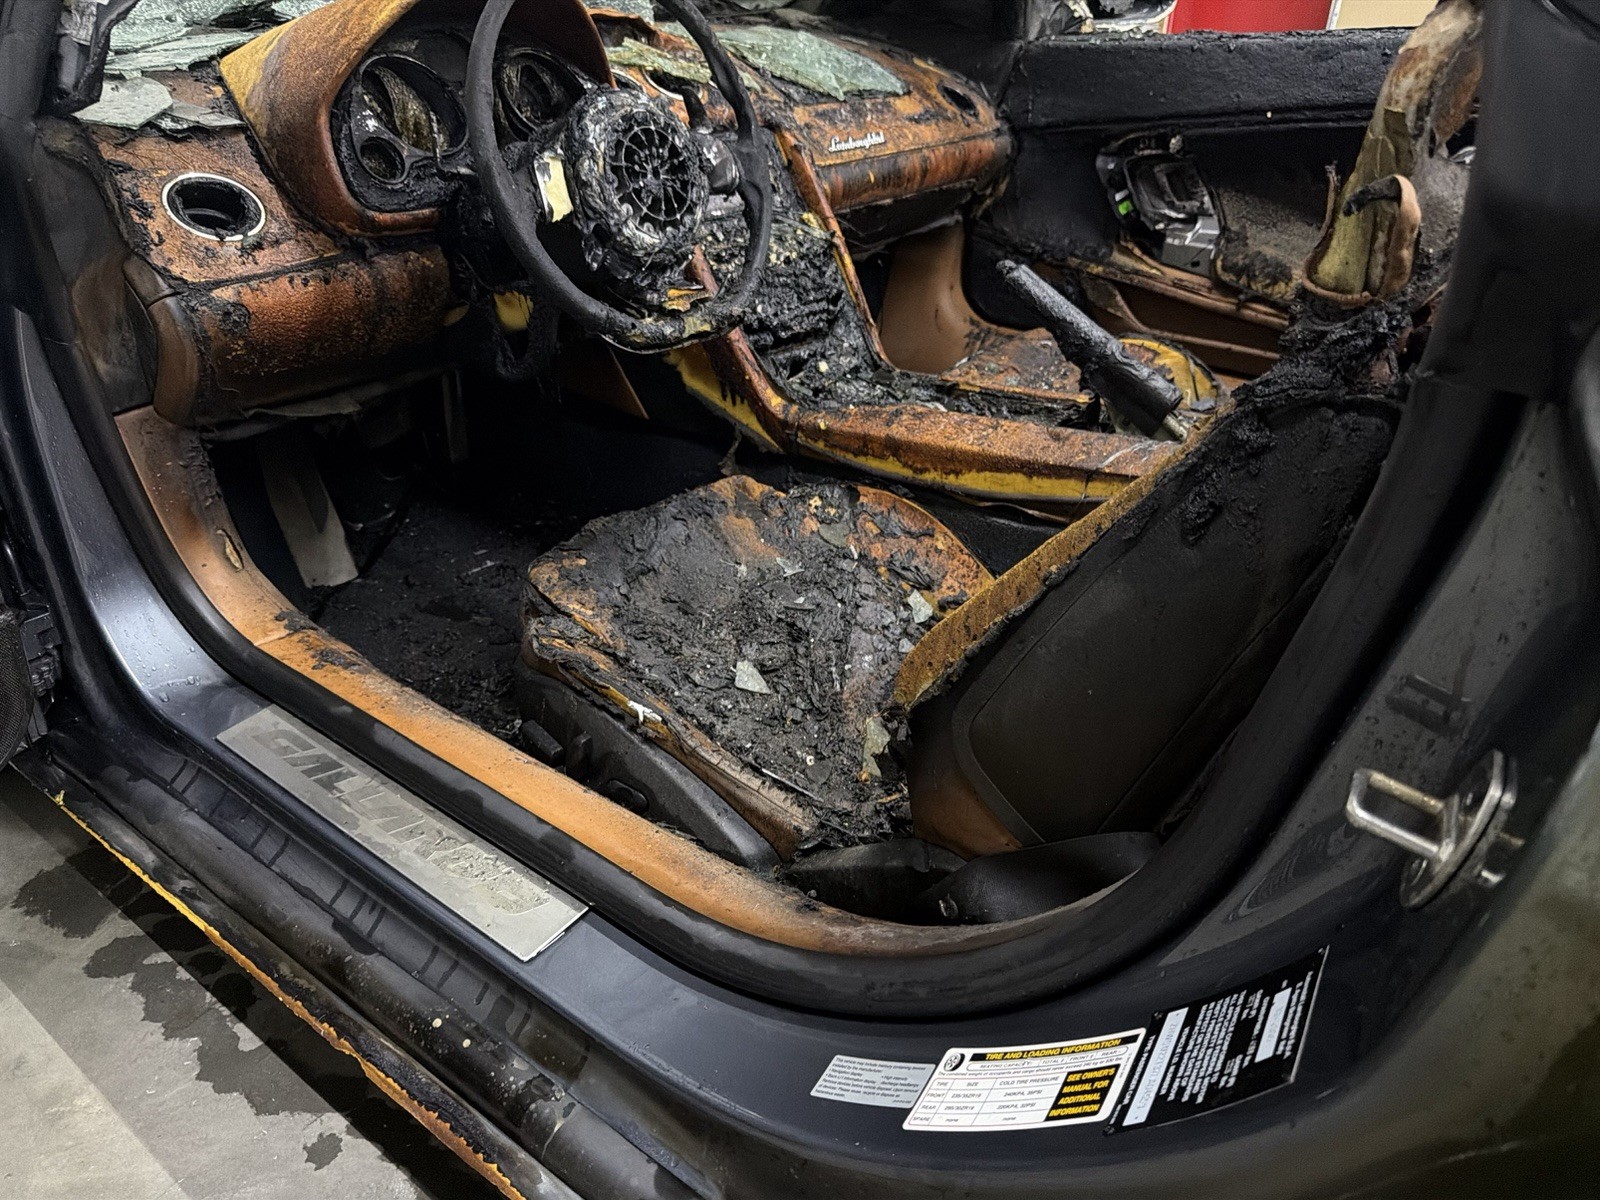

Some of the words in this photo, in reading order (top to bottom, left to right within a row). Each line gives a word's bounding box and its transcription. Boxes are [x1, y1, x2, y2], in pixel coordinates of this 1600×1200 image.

[1023, 1048, 1060, 1058] LOADING
[1061, 1039, 1121, 1054] INFORMATION
[1067, 1073, 1081, 1082] SEE
[1081, 1068, 1116, 1079] OWNER'S
[1062, 1083, 1092, 1093] MANUAL
[1093, 1080, 1110, 1089] FOR
[1058, 1093, 1101, 1105] ADDITIONAL
[1048, 1104, 1100, 1116] INFORMATION
